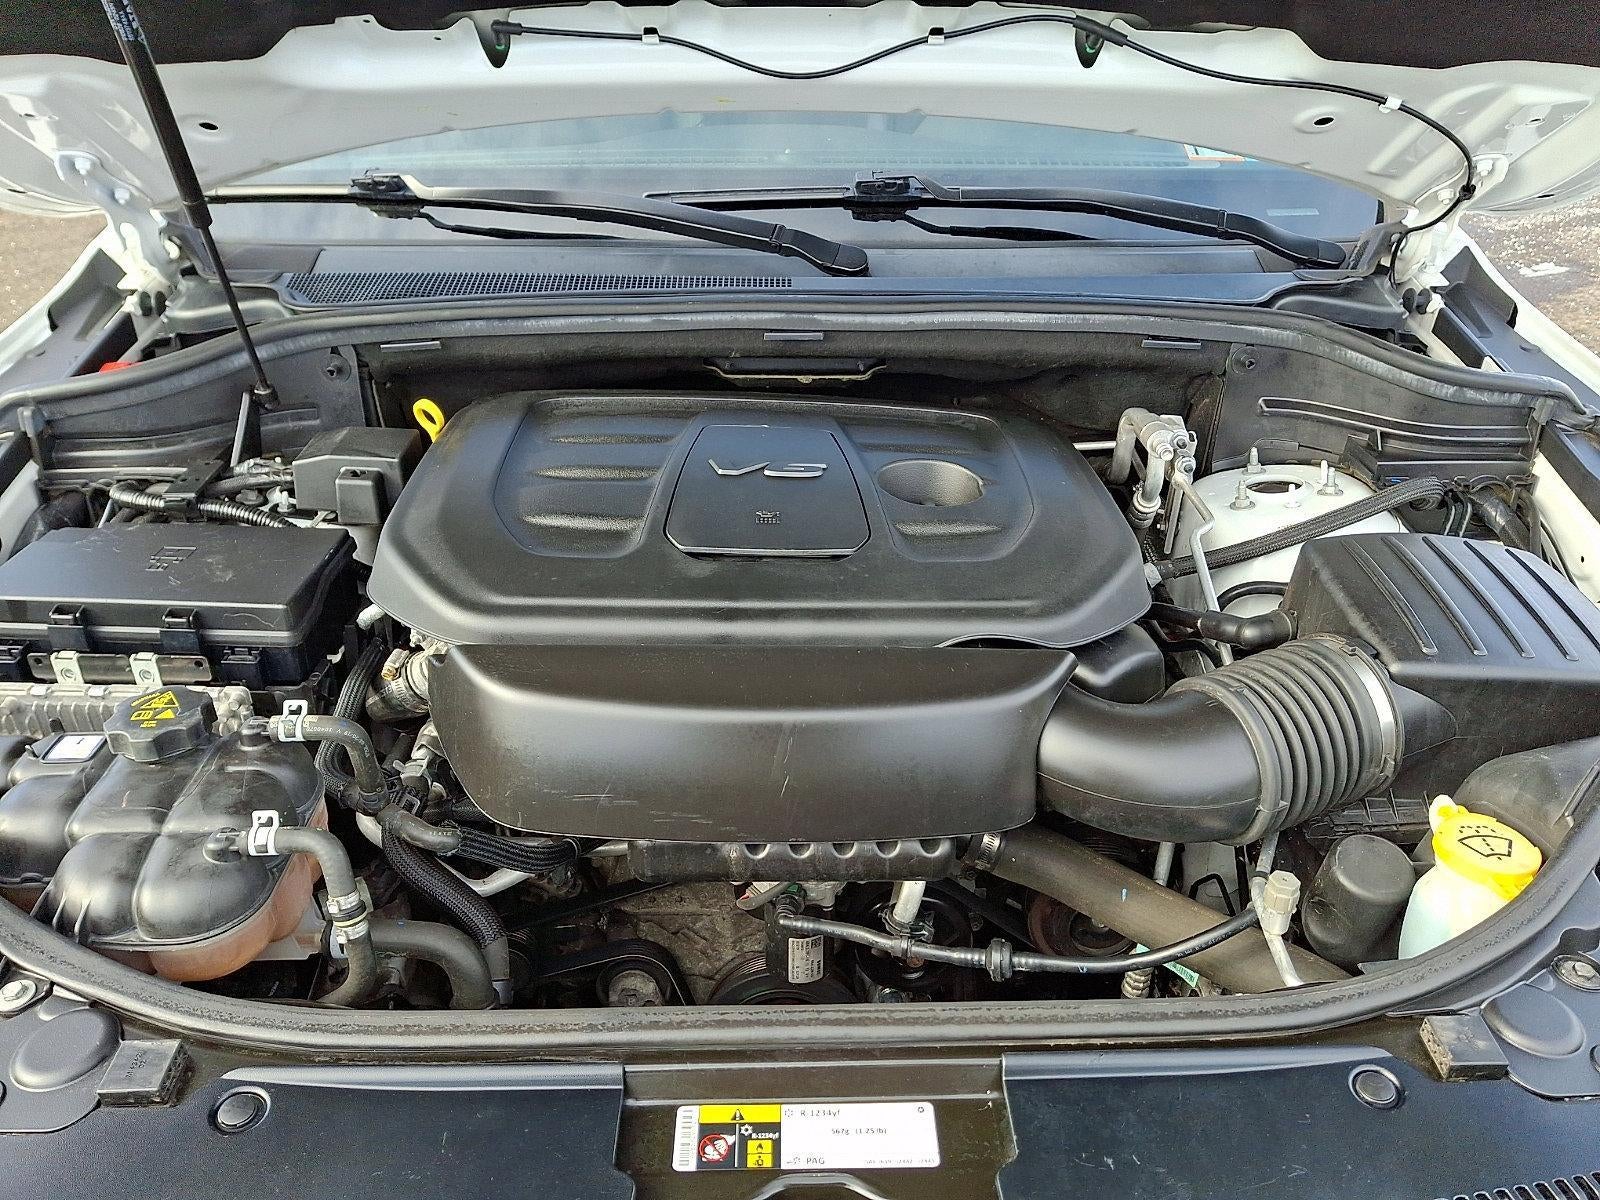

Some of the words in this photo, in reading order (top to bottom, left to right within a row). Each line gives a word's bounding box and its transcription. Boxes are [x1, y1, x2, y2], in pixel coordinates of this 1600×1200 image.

[708, 458, 828, 479] V6
[800, 1109, 840, 1118] R1234yf
[806, 1157, 825, 1165] PAG
